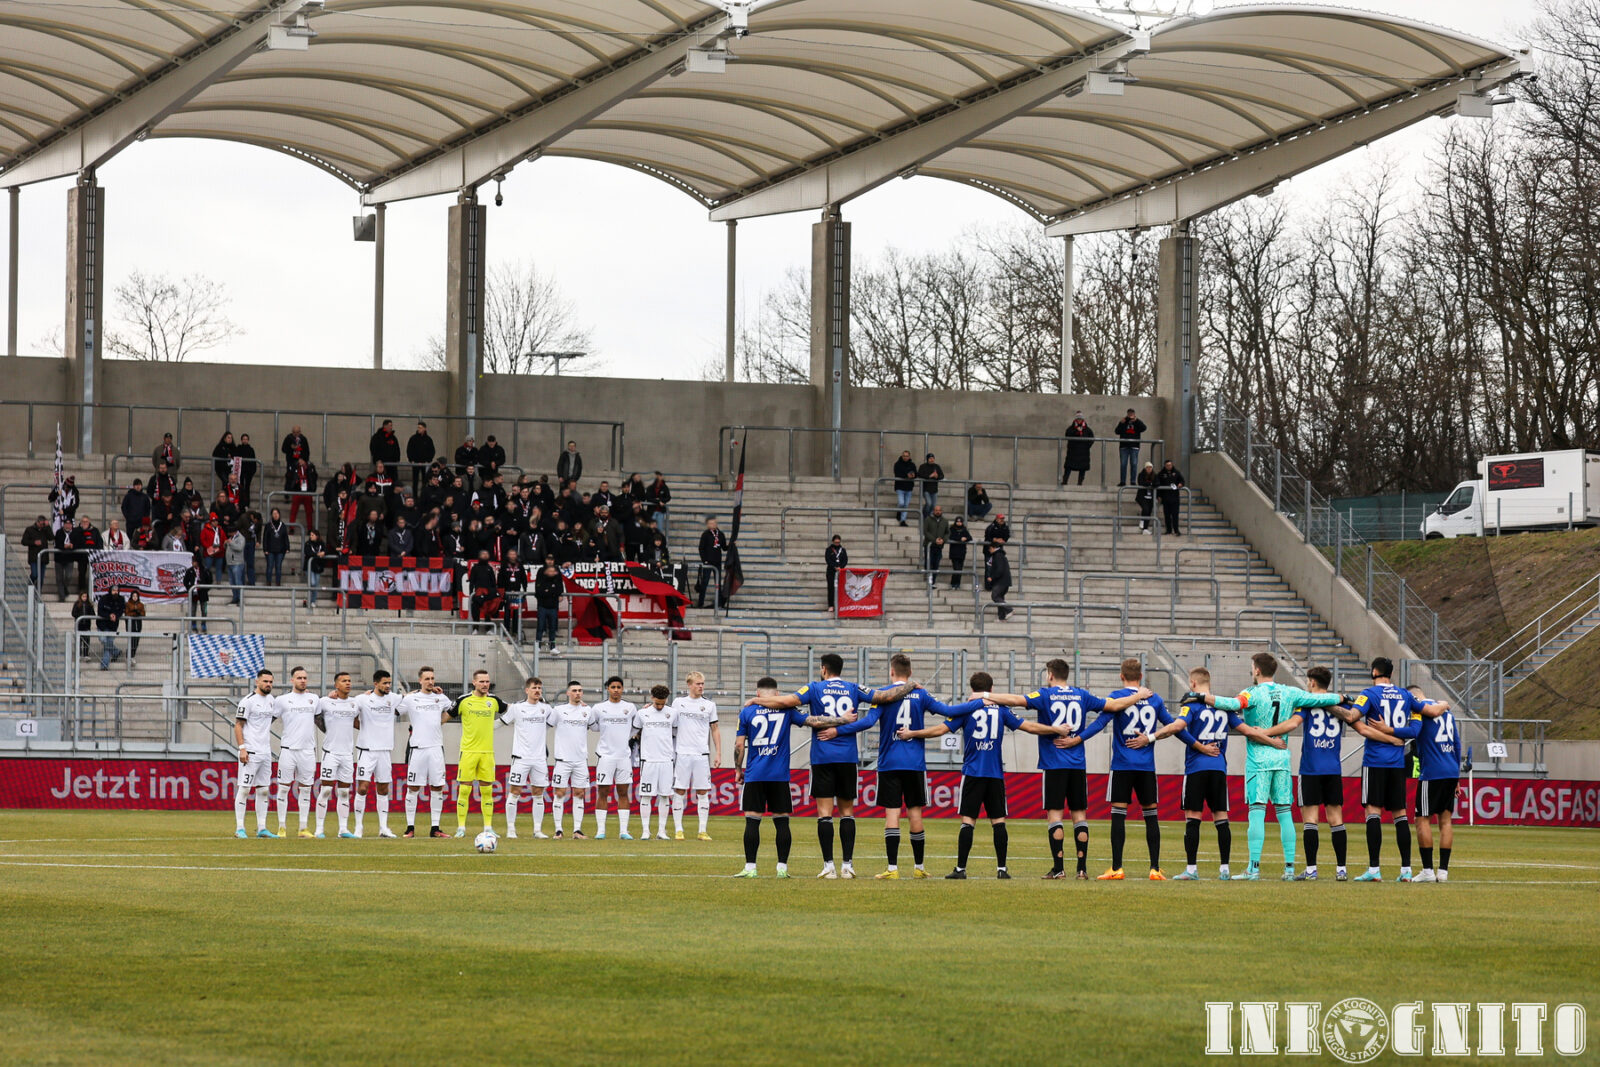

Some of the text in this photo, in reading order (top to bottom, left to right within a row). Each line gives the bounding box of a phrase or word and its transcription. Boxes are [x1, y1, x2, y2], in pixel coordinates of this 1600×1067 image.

[823, 688, 850, 696] GRIMALDI
[20, 723, 34, 734] C1
[751, 712, 785, 746] 27
[896, 699, 912, 730] 4
[971, 708, 999, 740] 31
[1050, 701, 1082, 732] 20
[1122, 705, 1156, 736] 29
[1198, 709, 1228, 740] 22
[1309, 708, 1340, 738] 33
[1380, 699, 1406, 729] 16
[945, 737, 957, 747] C2
[1491, 745, 1504, 755] C3
[51, 767, 141, 800] Jetzt
[150, 768, 190, 799] im
[322, 768, 333, 778] 22
[408, 772, 416, 782] 21
[510, 772, 521, 783] 23
[641, 783, 651, 793] 20
[1474, 785, 1600, 822] GLASFAS
